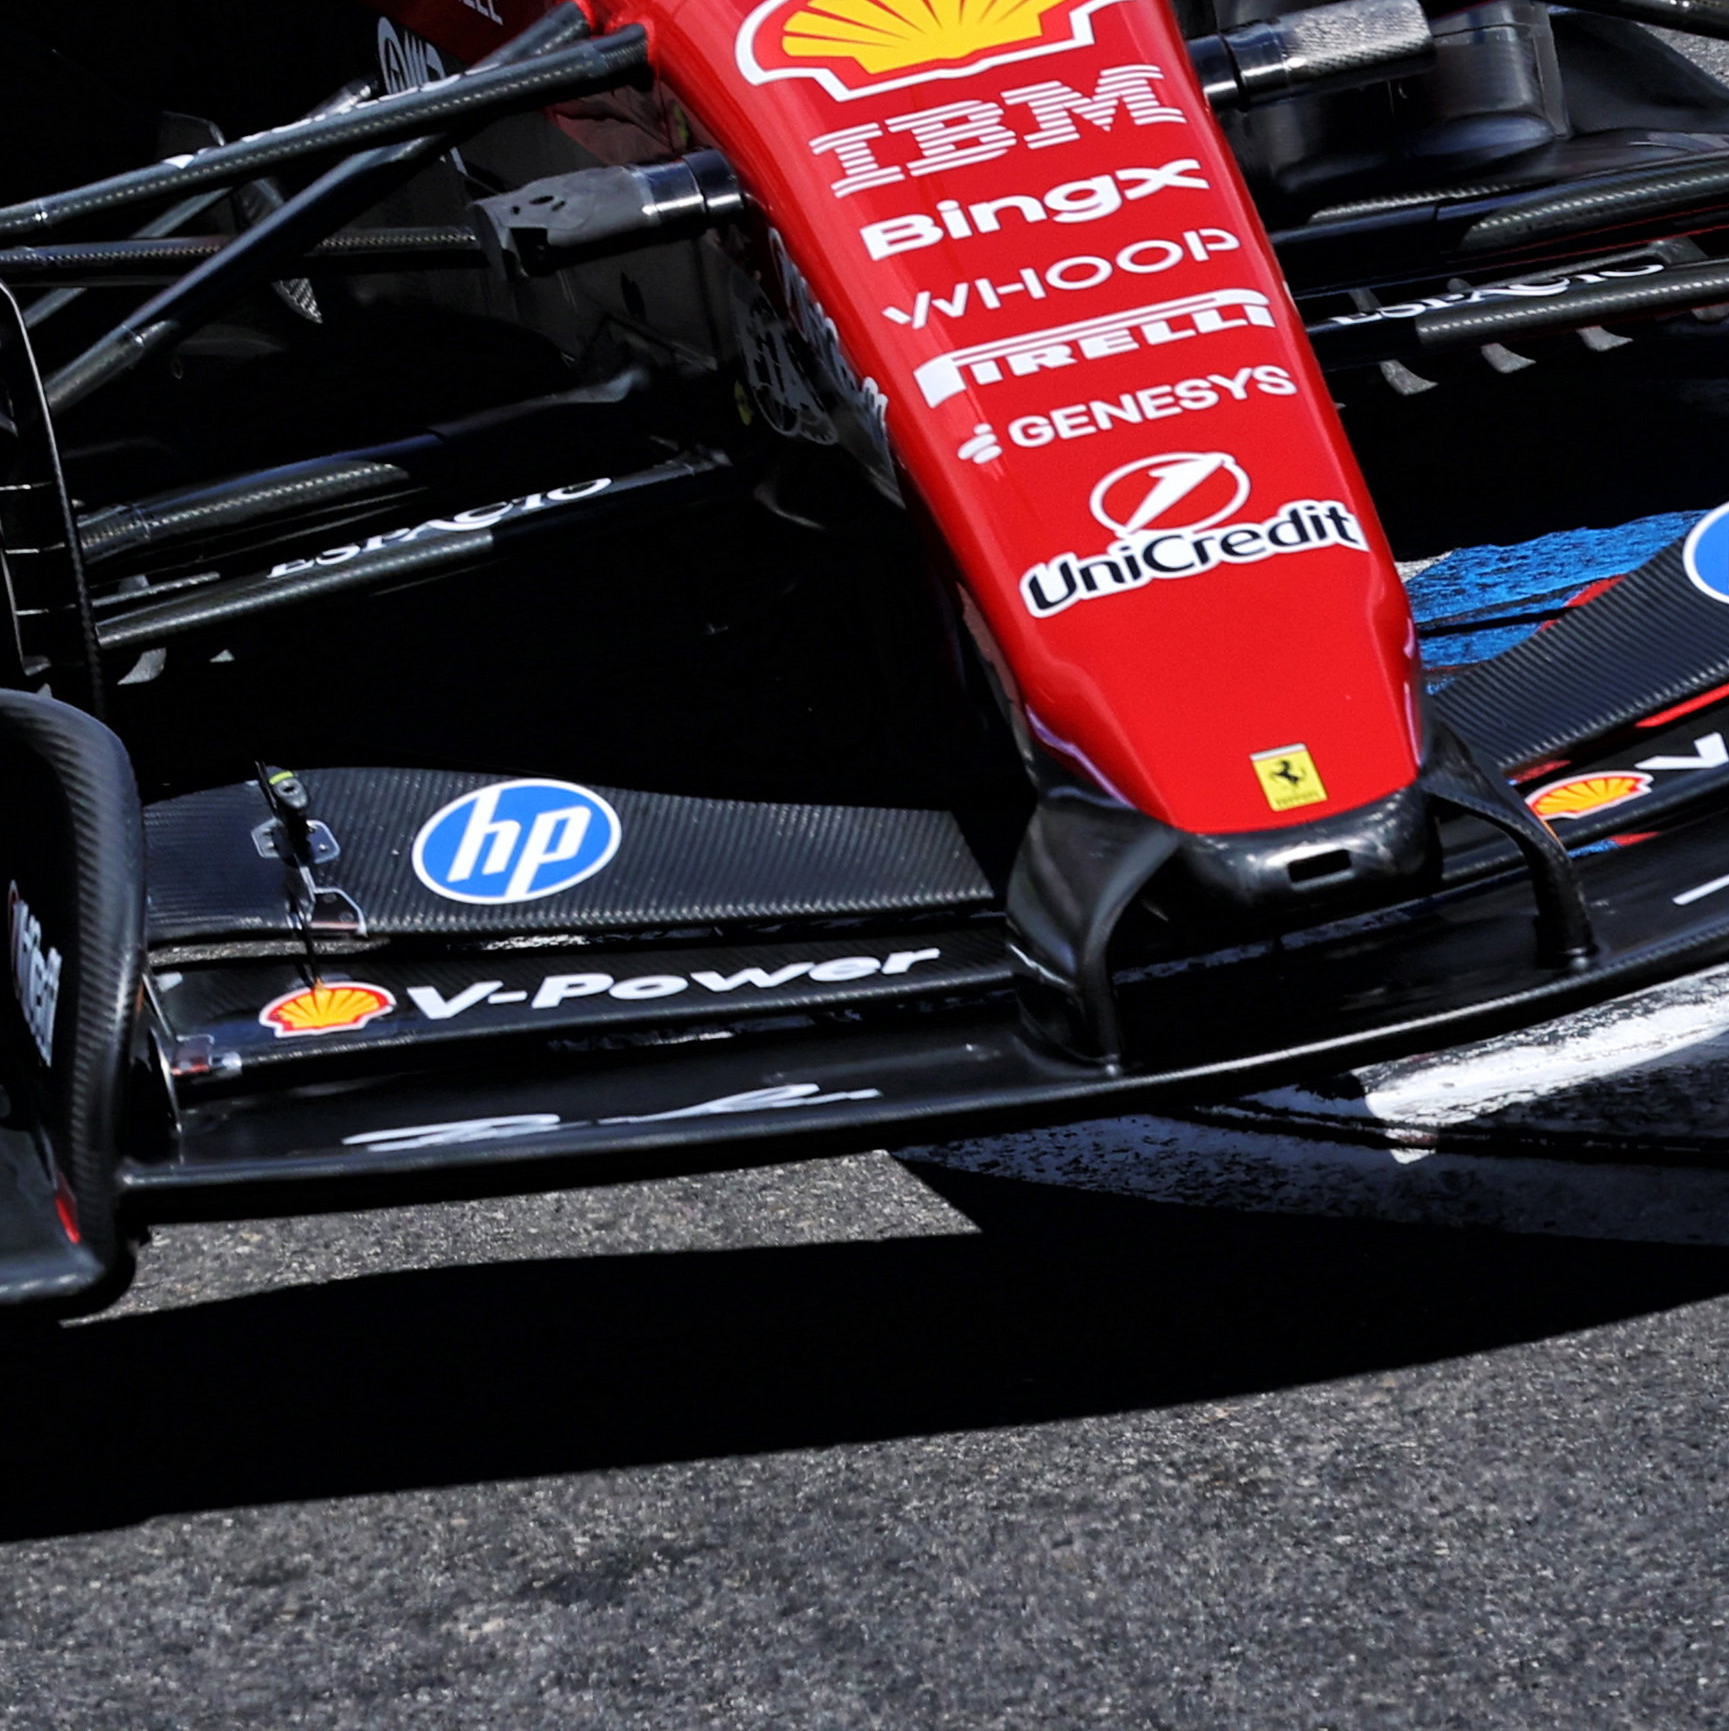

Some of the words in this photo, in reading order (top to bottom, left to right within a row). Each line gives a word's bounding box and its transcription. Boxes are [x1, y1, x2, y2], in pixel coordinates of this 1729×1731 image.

[808, 64, 1188, 199] IBM
[881, 227, 1241, 330] WHOOP
[913, 286, 1277, 409] PIRELLI
[1008, 364, 1297, 448] GENESYS
[1024, 503, 1358, 613] UniCredit
[444, 788, 592, 896] hp
[406, 946, 942, 1020] V-Power
